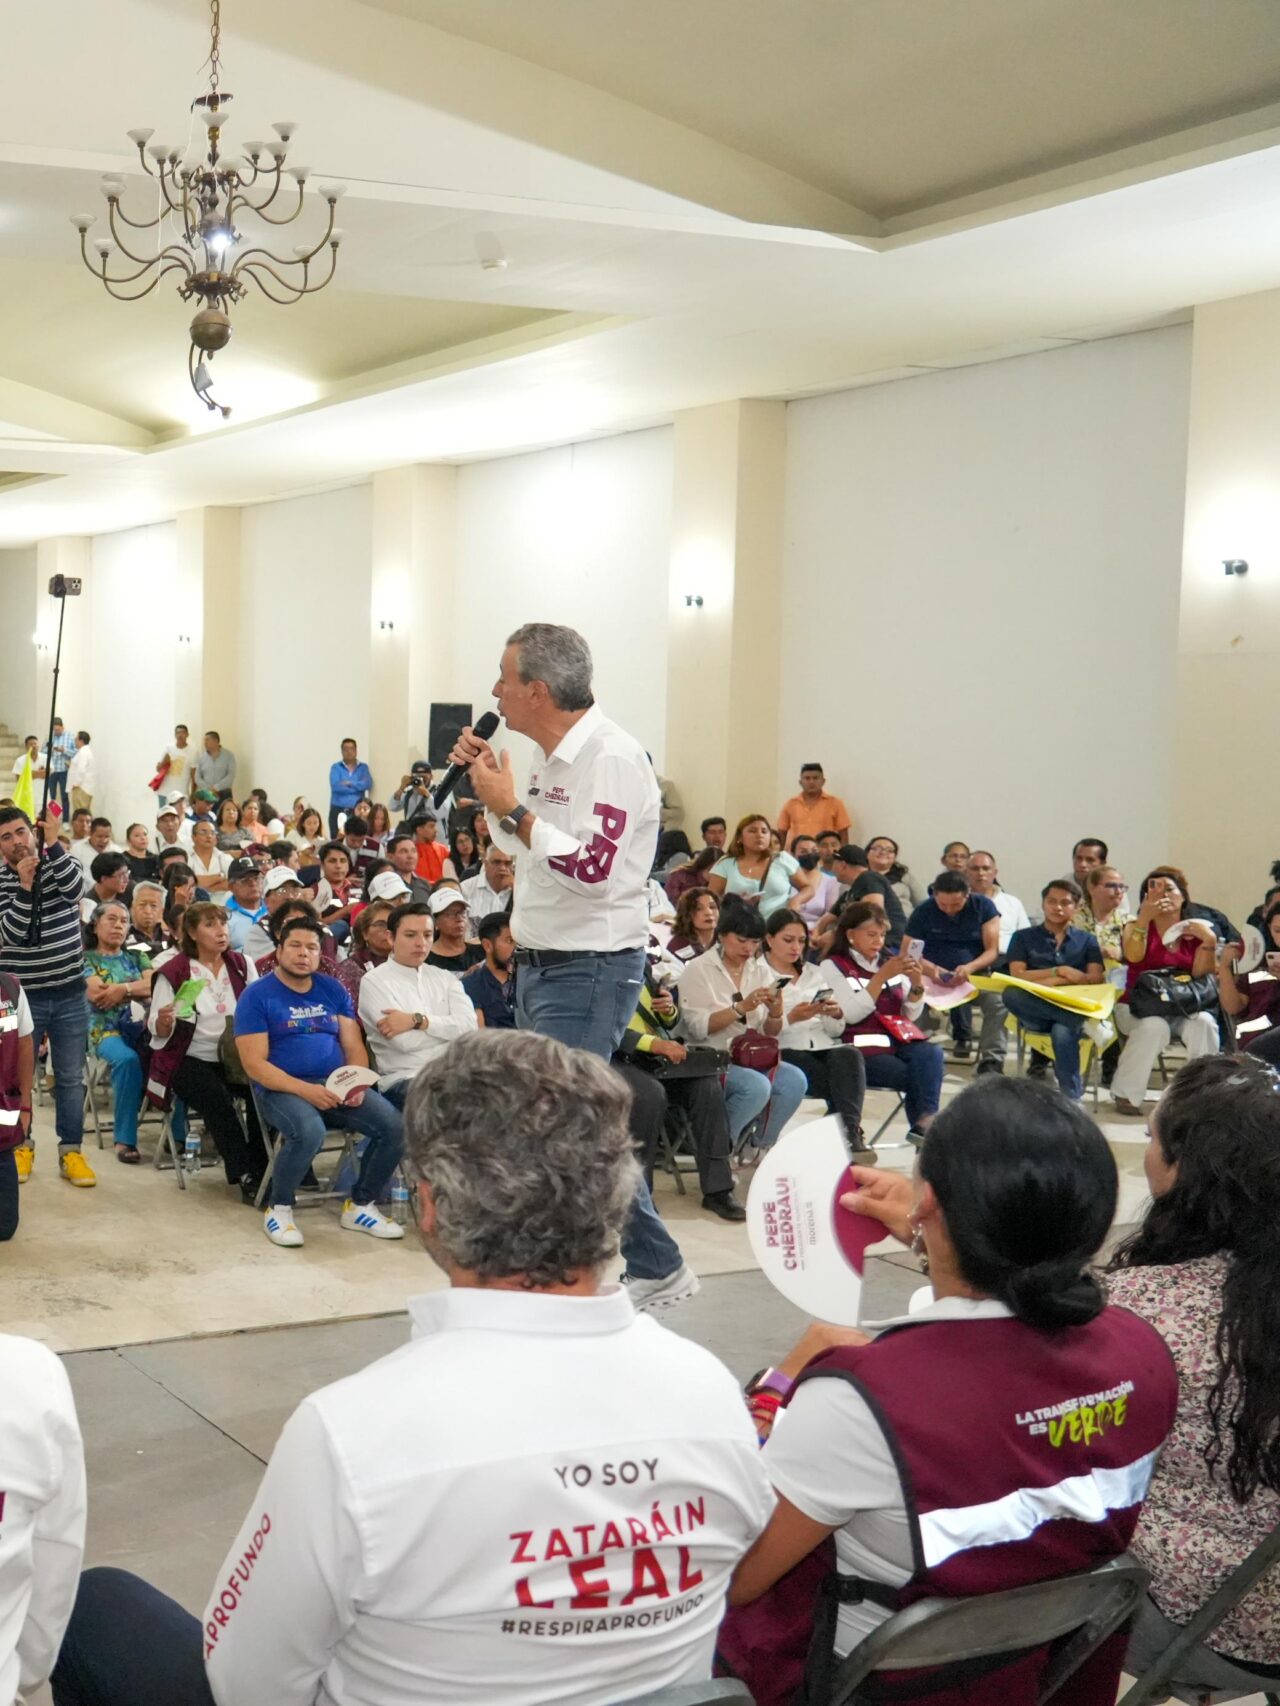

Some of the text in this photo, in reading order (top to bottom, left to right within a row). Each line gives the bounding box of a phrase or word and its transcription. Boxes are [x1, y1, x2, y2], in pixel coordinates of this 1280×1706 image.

[763, 1201, 780, 1248] PEPE
[775, 1177, 798, 1271] CHEDRAUI
[1015, 1380, 1135, 1425] LA TRANSFORMACIÓN
[1029, 1394, 1129, 1448] ES VERDE
[553, 1458, 661, 1490] YO SOY
[509, 1496, 706, 1563] ZATARÁIN
[515, 1545, 704, 1609] LEAL
[500, 1593, 705, 1636] #RESPIRAPROFUNDO
